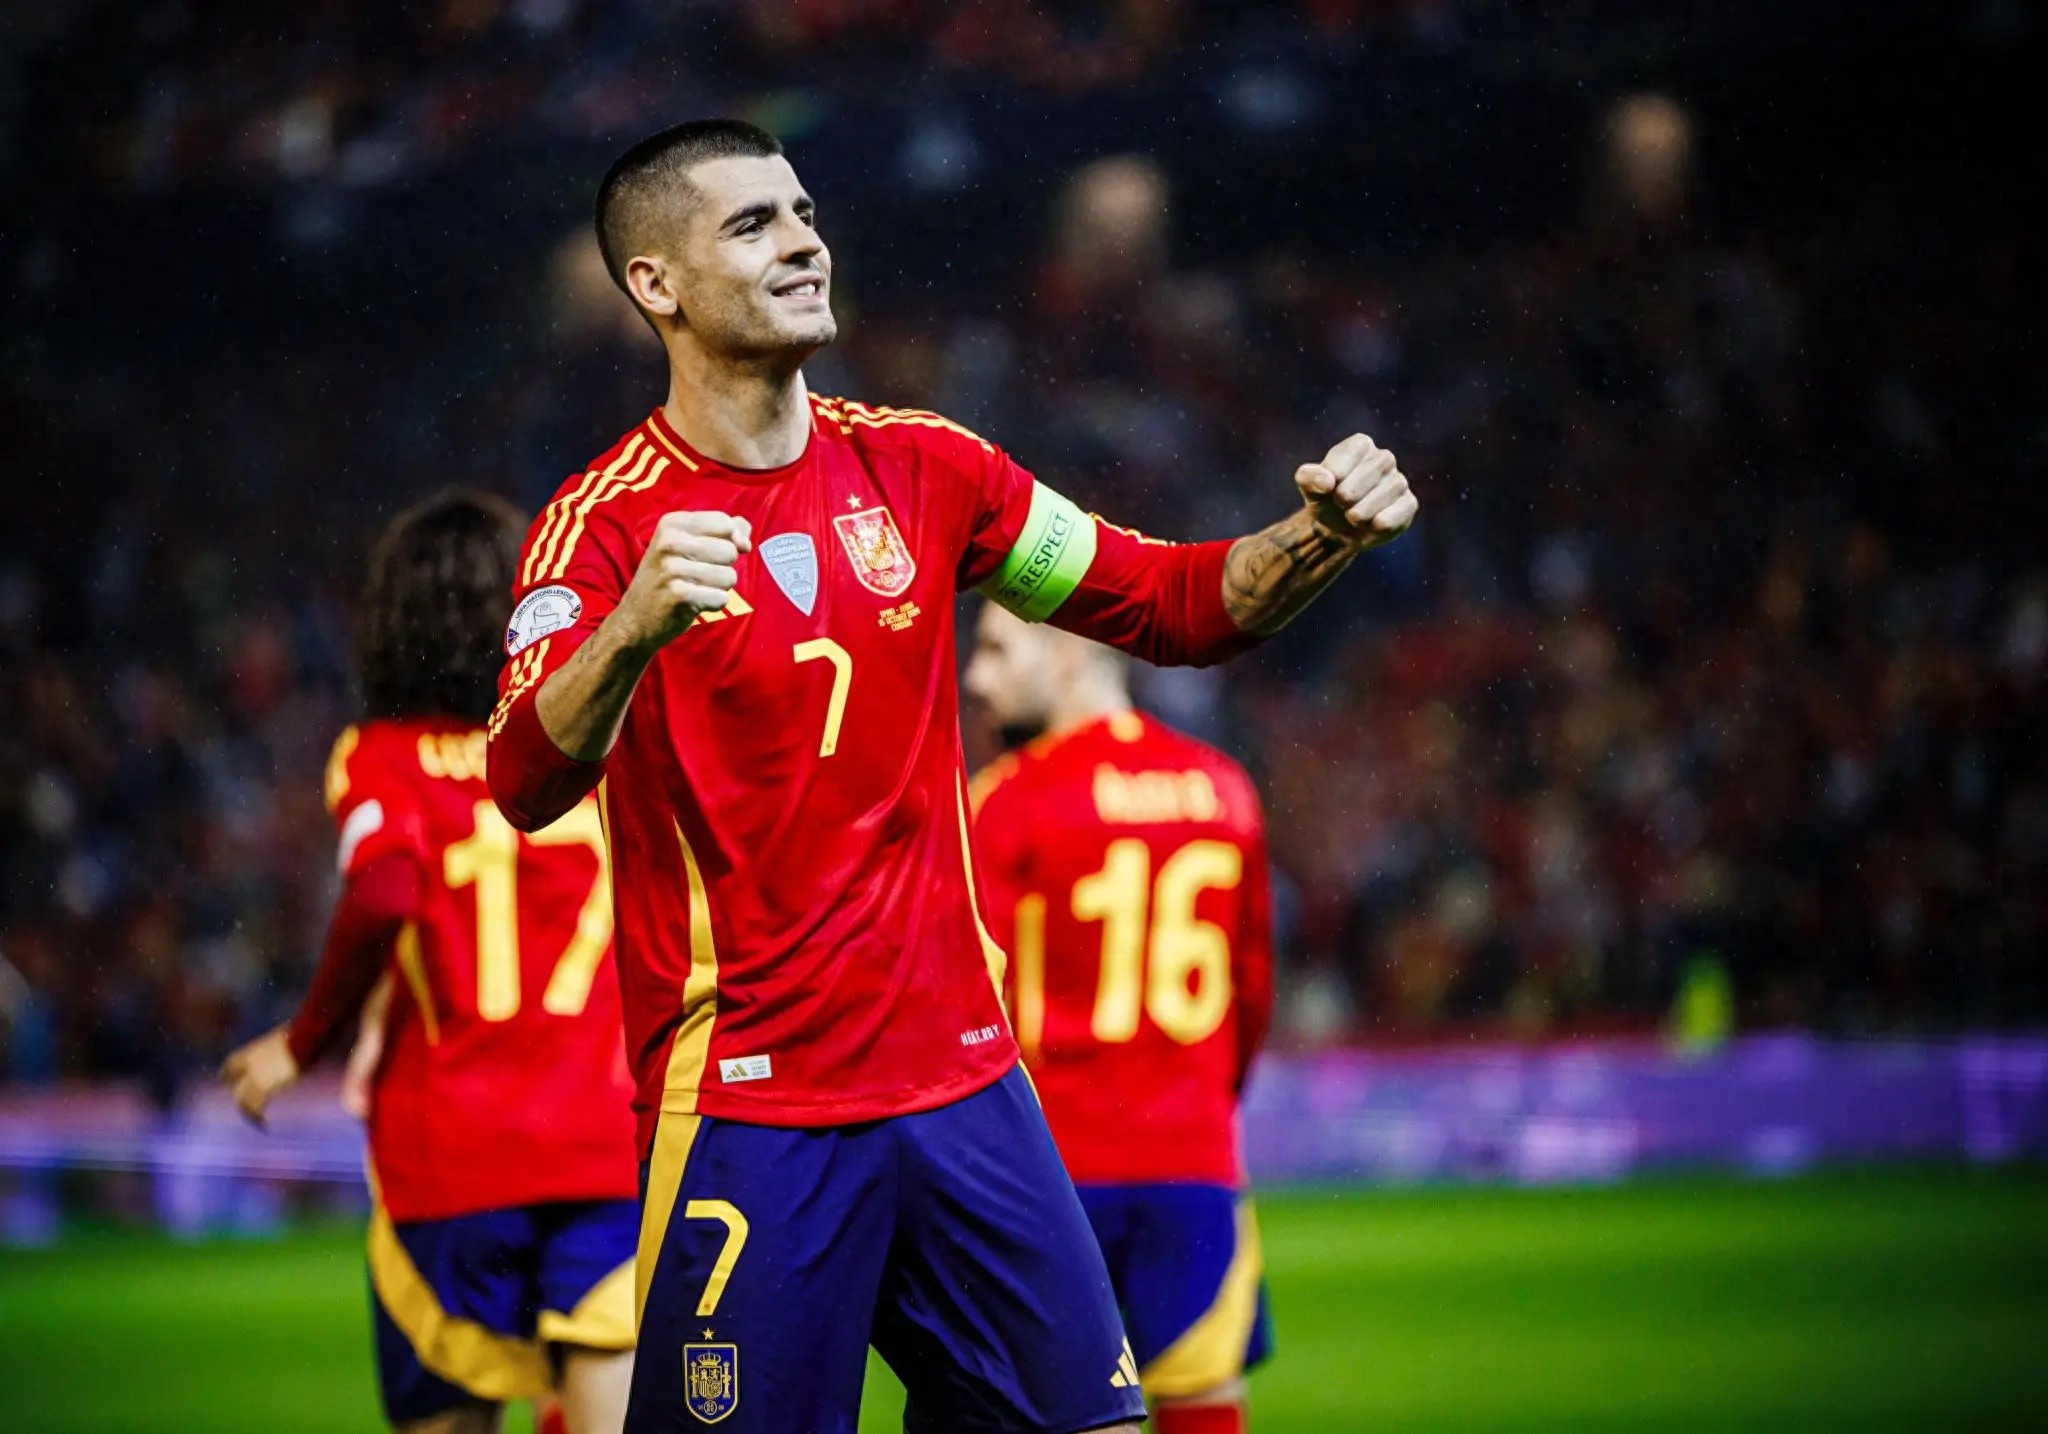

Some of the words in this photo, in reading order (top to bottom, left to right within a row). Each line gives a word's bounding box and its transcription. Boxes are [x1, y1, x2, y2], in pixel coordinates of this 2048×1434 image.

[527, 589, 553, 604] NATIONS
[553, 589, 574, 600] LEAGUE
[1019, 512, 1070, 588] RESPECT
[793, 637, 853, 758] 7
[443, 799, 614, 1022] 17
[1071, 838, 1243, 1045] 16
[684, 1200, 749, 1316] 7
